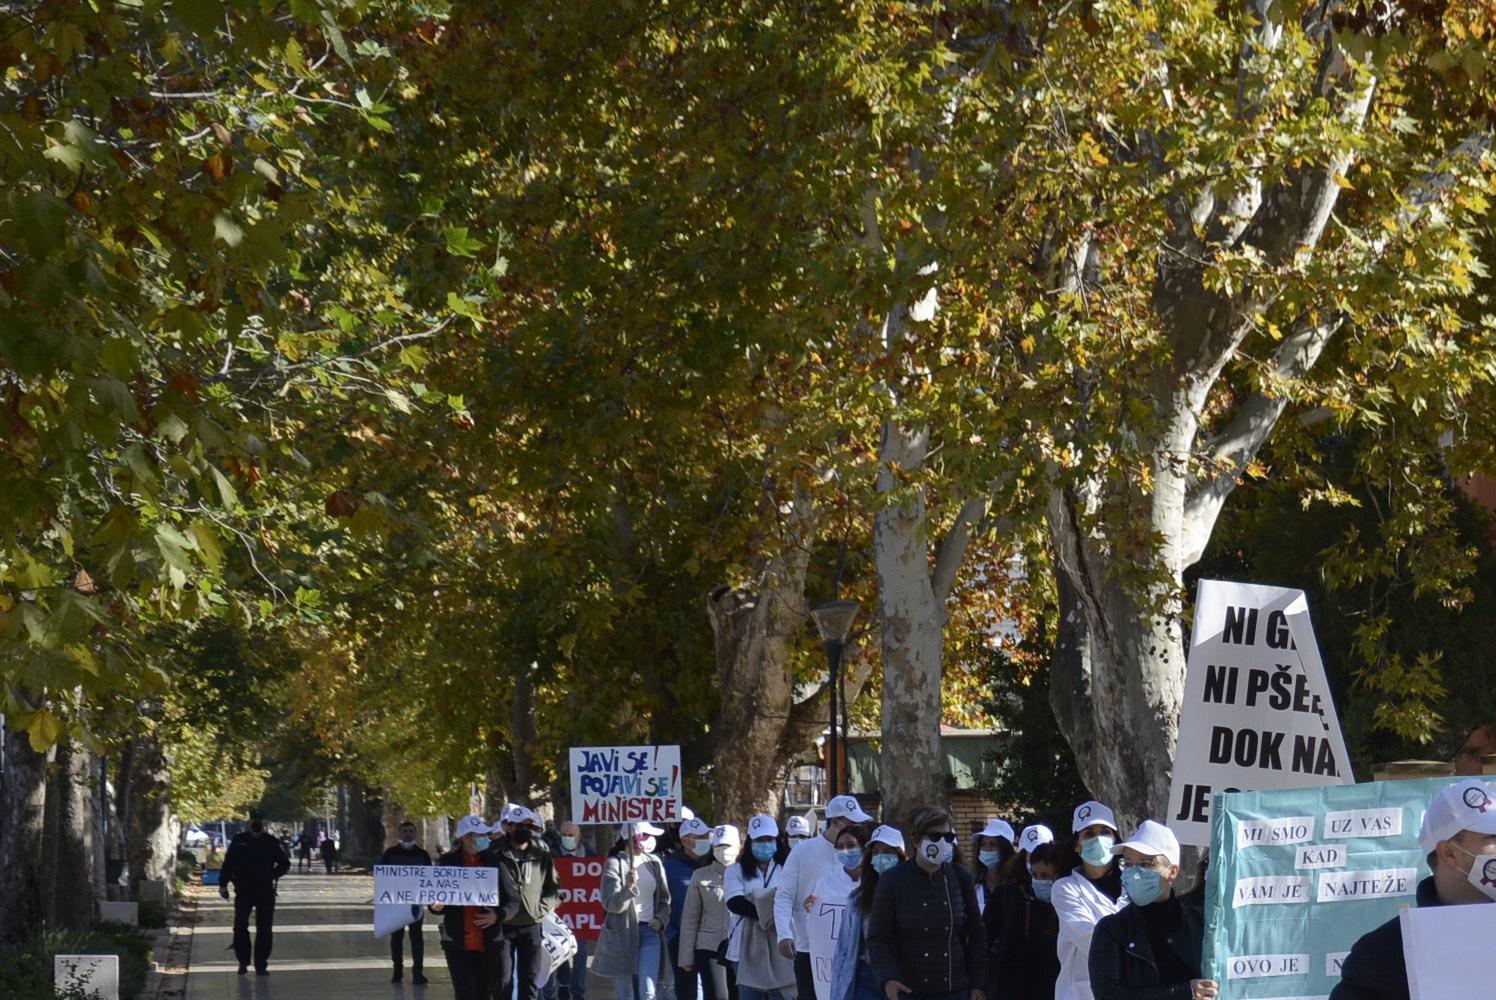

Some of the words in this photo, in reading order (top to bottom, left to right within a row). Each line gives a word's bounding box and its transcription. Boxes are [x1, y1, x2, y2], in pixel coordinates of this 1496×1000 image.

[1222, 606, 1258, 646] NI
[1265, 609, 1297, 651] G
[1203, 665, 1239, 705] NI
[1209, 726, 1285, 771] DOK
[1292, 735, 1341, 778] NA
[1176, 784, 1211, 825] JE
[1243, 828, 1263, 842] MI
[1271, 825, 1308, 841] SMO
[1331, 819, 1352, 833] UZ
[1360, 816, 1392, 832] VAS
[1302, 849, 1338, 865] KAD
[375, 866, 427, 878] MINISTRE
[433, 868, 469, 879] BORITE
[475, 870, 489, 879] SE
[420, 880, 433, 888] ZA
[436, 880, 460, 889] NAS
[380, 891, 392, 902] A
[397, 890, 414, 902] NE
[420, 890, 472, 902] PROTIV
[478, 893, 497, 905] NAS
[1238, 884, 1273, 900] VAM
[1282, 884, 1302, 898] JE
[1324, 873, 1407, 897] NAJTEŽE
[1233, 959, 1271, 975] OVO
[1280, 957, 1299, 972] JE
